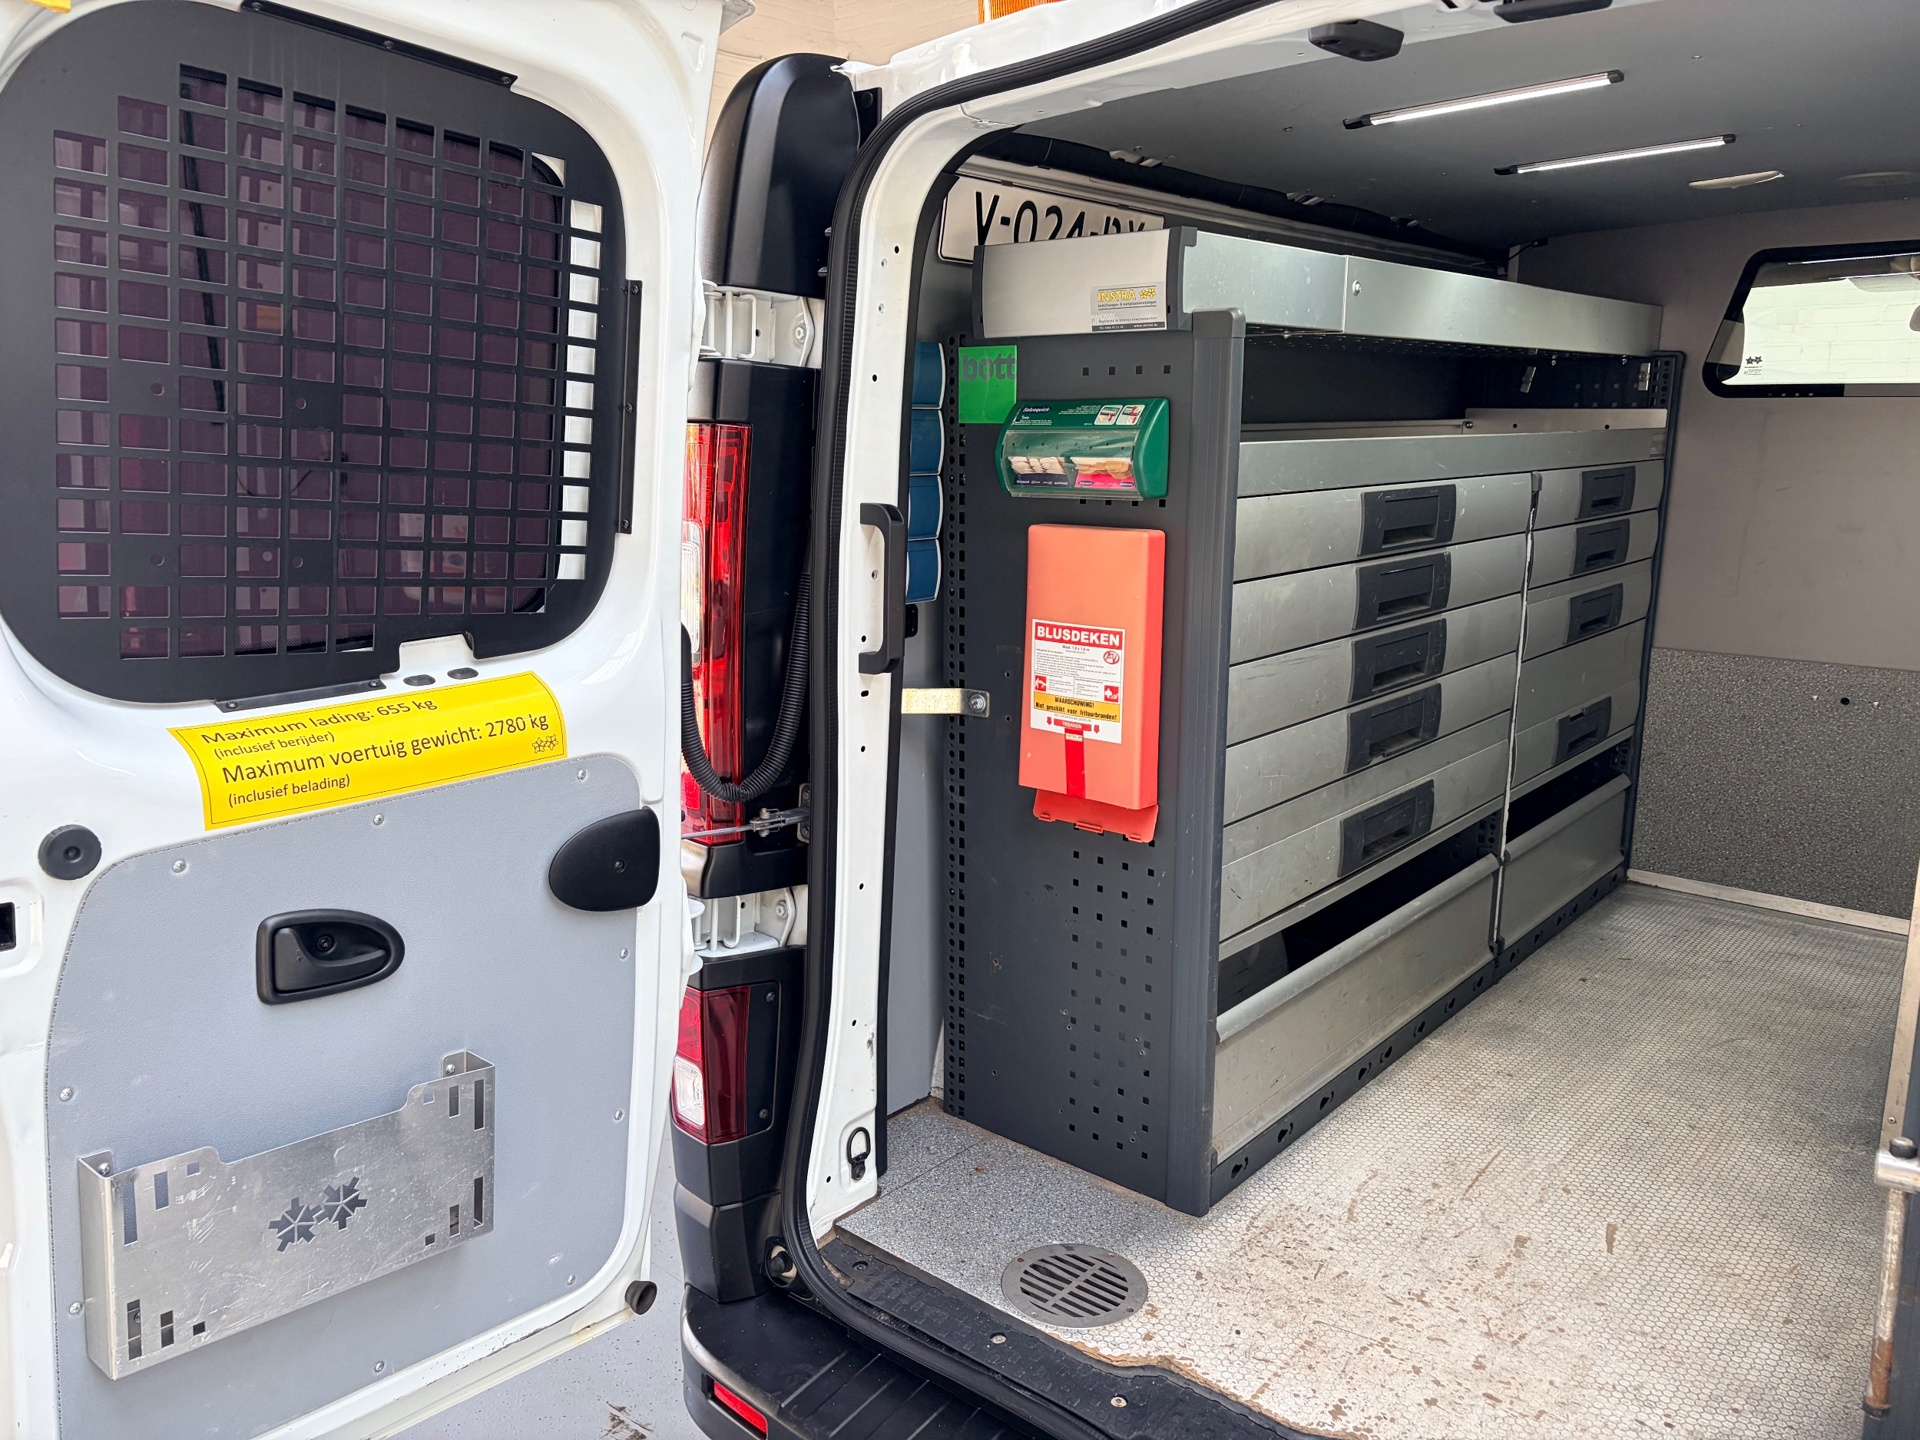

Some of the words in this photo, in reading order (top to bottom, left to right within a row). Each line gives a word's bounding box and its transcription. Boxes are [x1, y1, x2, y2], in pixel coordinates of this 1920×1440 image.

[1097, 288, 1136, 302] INSTRA
[962, 353, 1016, 380] bott
[1037, 625, 1120, 647] BLUSDEKEN
[1035, 701, 1045, 709] Niet
[1046, 704, 1065, 713] geschikt
[1054, 696, 1095, 709] WAARSCHUWING!
[200, 721, 307, 744] Maximum
[309, 710, 375, 728] lading:
[376, 702, 411, 716] 655
[412, 700, 438, 711] kg
[1061, 721, 1082, 729] TREKKEN
[214, 740, 275, 760] (inclusief
[279, 731, 335, 749] berijder)
[222, 754, 325, 784] Maximum
[329, 740, 408, 765] voertuig
[411, 727, 483, 756] gewicht:
[485, 716, 527, 738] 2780
[529, 713, 549, 731] kg
[228, 783, 289, 809] (inclusief
[292, 773, 351, 795] belading)
